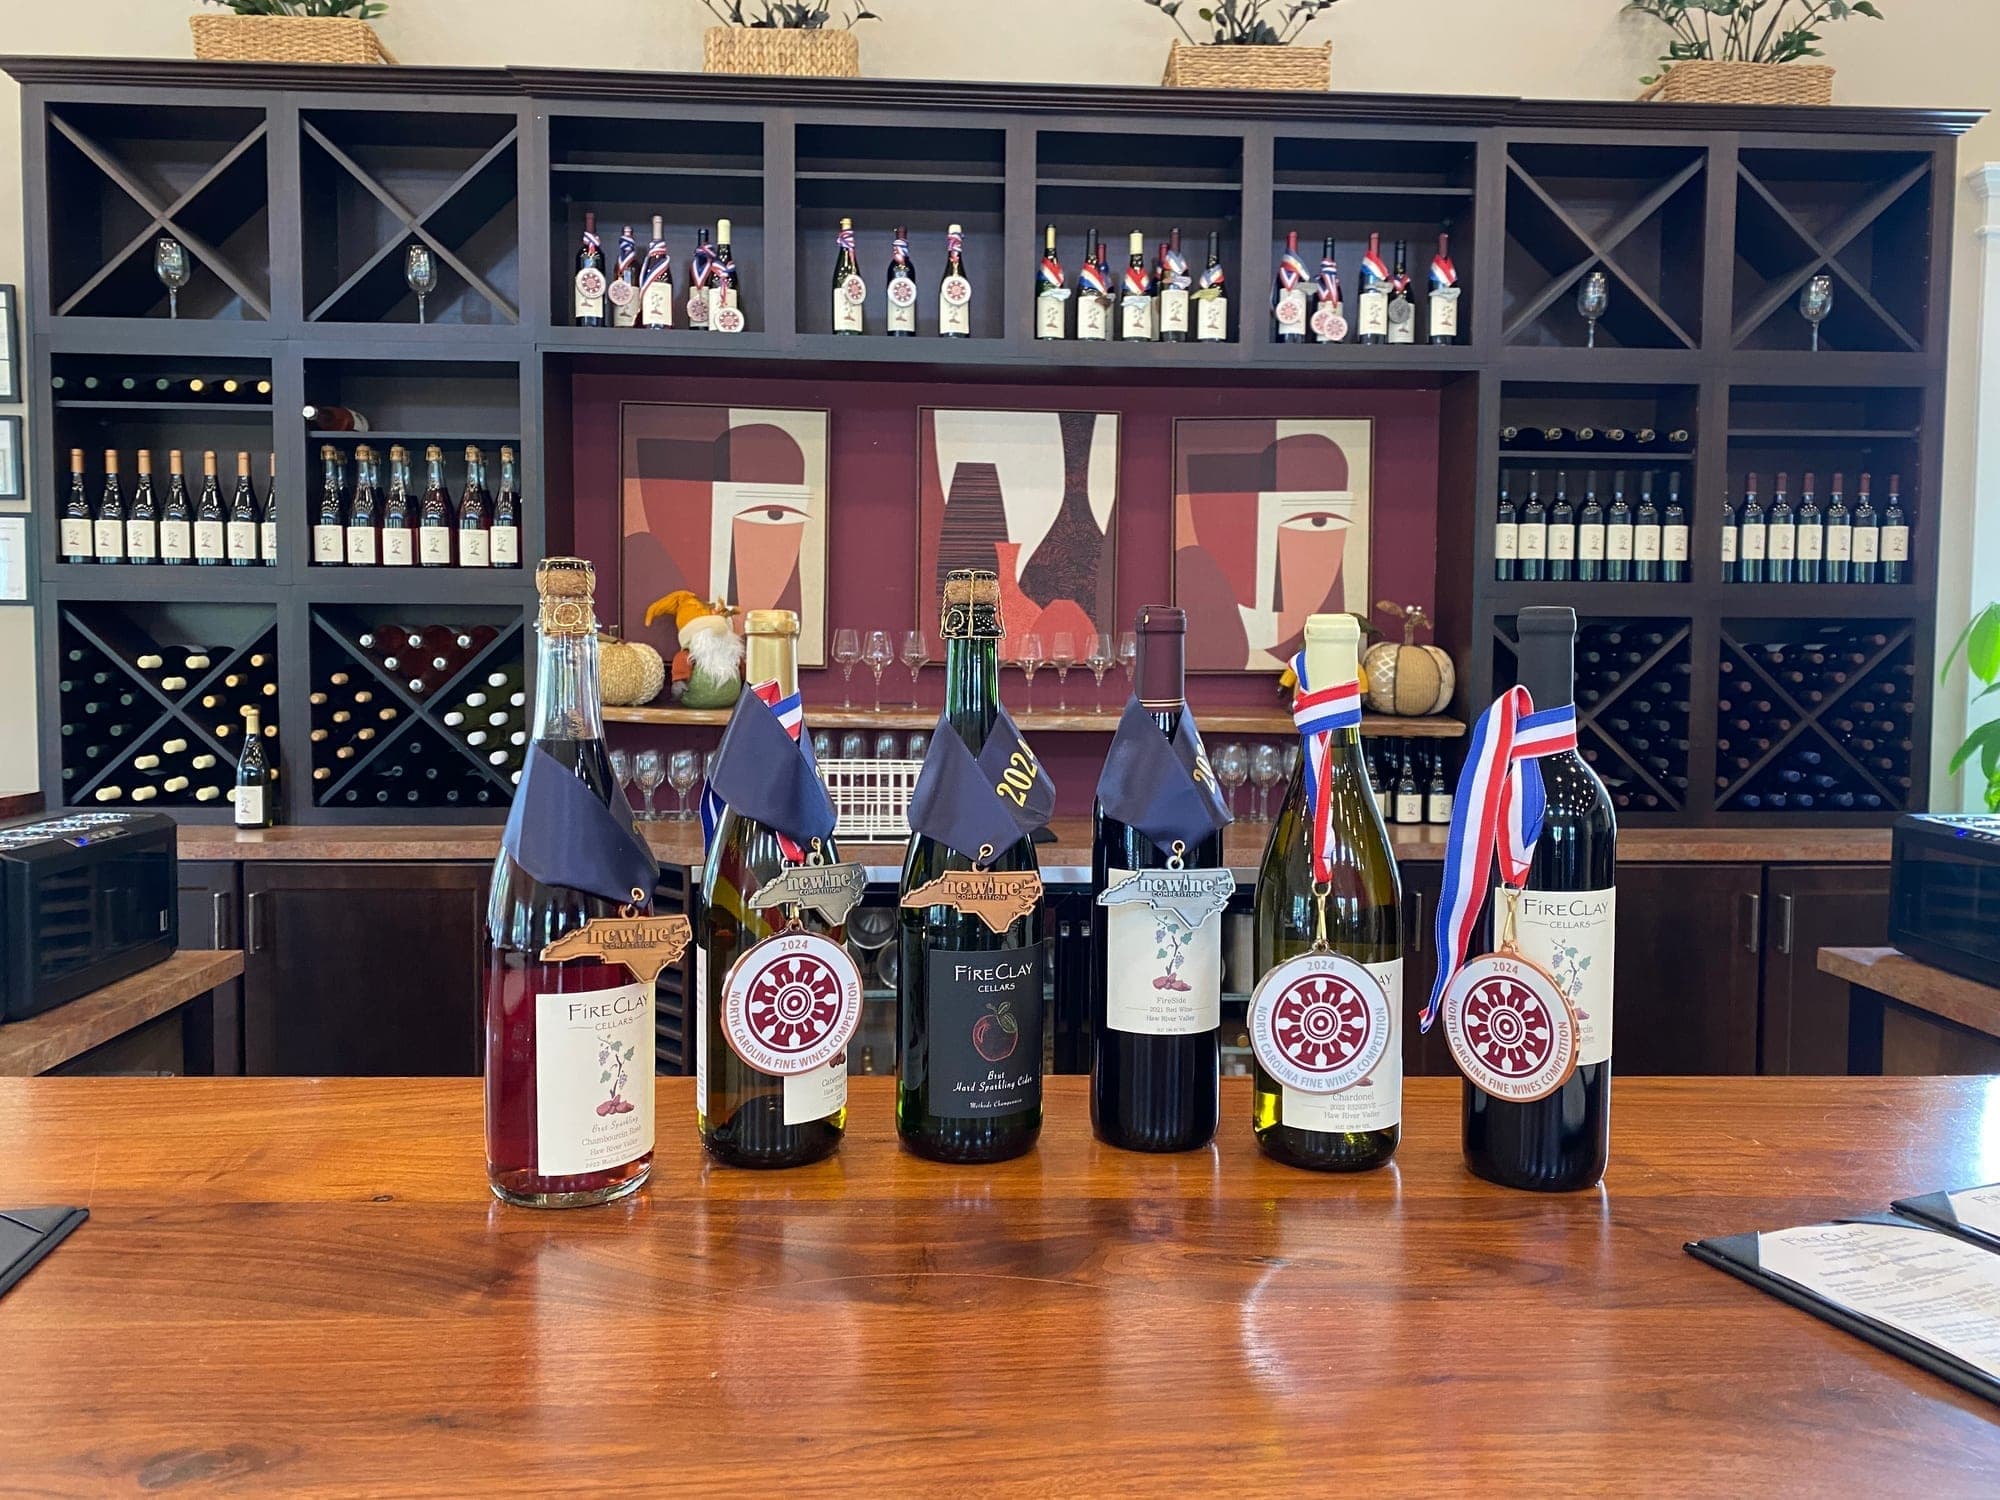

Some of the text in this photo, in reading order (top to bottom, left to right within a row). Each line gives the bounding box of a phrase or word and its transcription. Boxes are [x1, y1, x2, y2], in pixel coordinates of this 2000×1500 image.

[956, 893, 1008, 901] COMPETITION
[1549, 920, 1591, 929] CELLARS
[603, 941, 657, 950] COMPETITION
[781, 940, 808, 951] 2024
[1307, 960, 1335, 971] 2024
[1492, 962, 1519, 974] 2024
[977, 982, 1016, 993] CELLARS
[1447, 998, 1458, 1033] NORTH
[595, 1016, 634, 1031] CELLARS
[729, 982, 857, 1069] NORTH CAROLINA FINE WINES COMPETITION
[1255, 1006, 1387, 1089] NORTH CAROLINA FINE WINES COMPETITION
[1540, 1021, 1569, 1086] COMPETITION
[1452, 1036, 1487, 1083] CAROLINA
[987, 1070, 1005, 1081] Brut
[952, 1073, 1033, 1093] Hard Sparkling Cider
[1488, 1078, 1510, 1093] FINE
[1511, 1081, 1542, 1095] WINES
